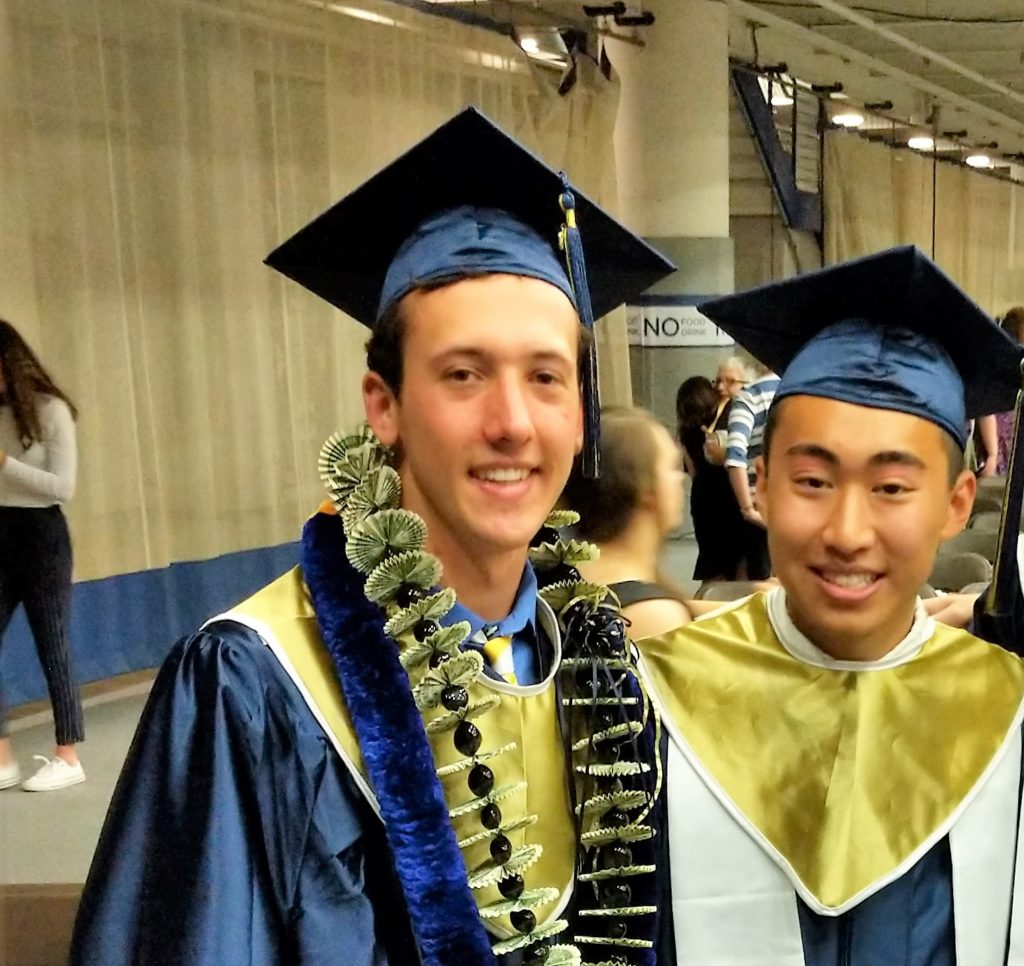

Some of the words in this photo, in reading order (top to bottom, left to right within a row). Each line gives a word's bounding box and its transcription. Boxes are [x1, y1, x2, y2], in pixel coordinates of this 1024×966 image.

[681, 318, 706, 326] FOOD
[644, 316, 680, 337] NO
[681, 328, 706, 336] DRINK
